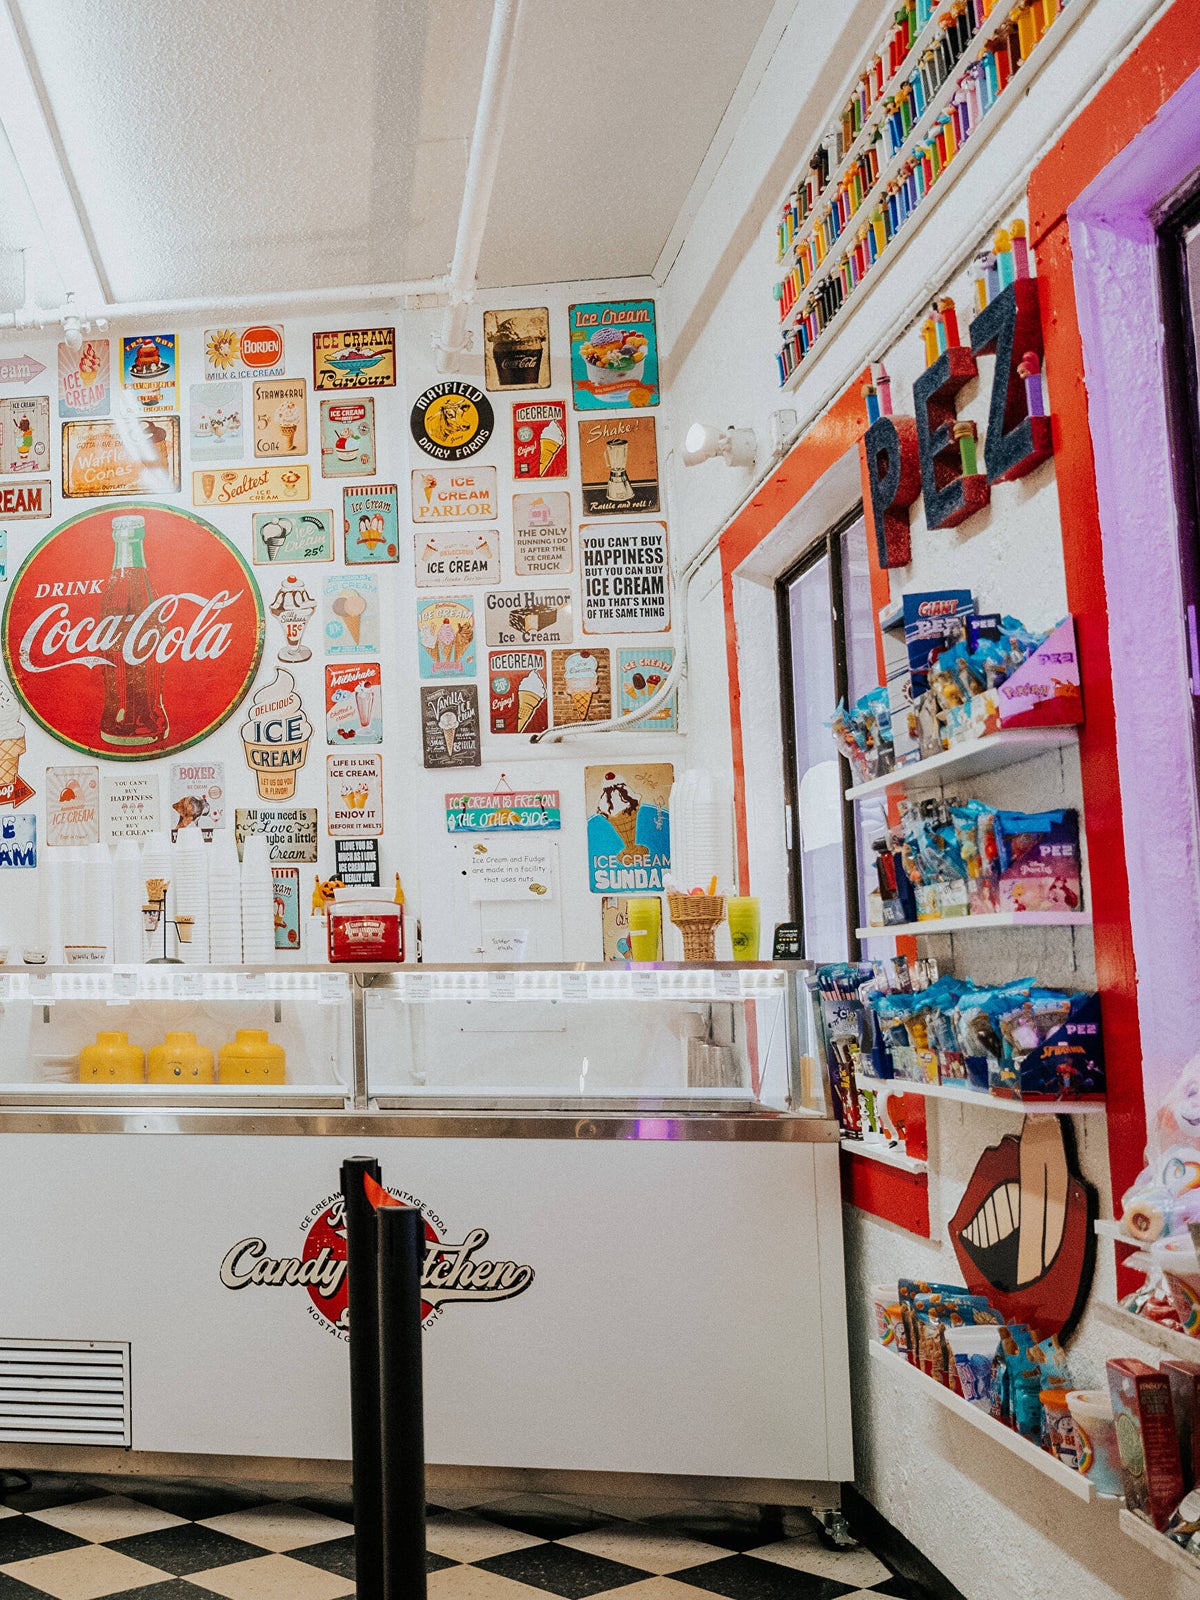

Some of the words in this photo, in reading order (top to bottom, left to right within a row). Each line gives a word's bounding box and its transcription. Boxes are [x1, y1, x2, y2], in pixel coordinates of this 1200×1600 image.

[576, 311, 600, 327] Ice
[601, 308, 651, 325] Cream
[125, 337, 143, 352] TRY
[155, 336, 174, 349] OUR
[243, 340, 279, 354] BORDEN
[315, 333, 339, 349] ICE
[343, 331, 393, 348] CREAM
[501, 356, 537, 369] Coca-Cola
[317, 370, 391, 389] Parlour
[65, 383, 106, 407] CREAM
[256, 387, 304, 400] STRAWBERRY
[416, 382, 484, 410] MAYFIELD
[517, 406, 562, 420] ICECREAM
[864, 278, 1050, 570] PEZ
[418, 436, 451, 459] DAIRY
[455, 429, 490, 458] FARMS
[84, 465, 133, 483] Cones
[218, 470, 269, 502] Sealtest
[450, 477, 475, 487] ICE
[437, 490, 489, 501] CREAM
[351, 501, 362, 514] Ice
[365, 499, 392, 513] Cream
[419, 503, 492, 518] PARLOR
[590, 501, 616, 512] Rattle
[617, 500, 631, 509] and
[583, 538, 605, 549] YOU
[607, 536, 638, 548] CAN'T
[641, 535, 662, 546] BUY
[304, 545, 324, 557] 25¢
[584, 547, 664, 566] HAPPINESS
[427, 562, 444, 574] ICE
[449, 560, 488, 573] CREAM
[527, 563, 560, 571] TRUCK
[35, 579, 104, 599] DRINK
[341, 582, 378, 593] CREAM
[586, 578, 610, 597] ICE
[613, 575, 664, 596] CREAM
[487, 594, 521, 610] Good
[524, 592, 571, 608] Humor
[586, 598, 606, 608] AND
[607, 597, 639, 607] THAT'S
[641, 596, 665, 606] KIND
[918, 599, 959, 616] GIANT
[420, 610, 435, 622] ICE
[436, 608, 474, 620] CREAM
[19, 589, 244, 673] Coca-Cola
[286, 624, 303, 638] 15¢
[971, 619, 996, 629] PEZ
[499, 632, 516, 644] Ice
[522, 631, 561, 643] Cream
[492, 653, 543, 670] ICECREAM
[621, 660, 637, 673] ICE
[639, 658, 672, 672] CREAM
[330, 668, 376, 687] Milkshake
[255, 695, 294, 716] DELICIOUS
[428, 691, 466, 720] VANILLA
[253, 715, 303, 743] ICE
[251, 748, 303, 767] CREAM
[179, 767, 216, 780] BOXER
[330, 770, 344, 778] ICE
[346, 769, 378, 778] CREAM,
[449, 797, 465, 809] ICE
[467, 795, 500, 808] CREAM
[502, 795, 511, 808] IS
[514, 794, 541, 807] FREE
[541, 794, 556, 807] ON
[52, 813, 67, 825] ICE
[68, 808, 95, 823] CREAM
[456, 812, 476, 826] THE
[480, 812, 515, 826] OTHER
[520, 811, 549, 825] SIDE
[269, 845, 306, 860] Cream
[1039, 845, 1073, 857] PEZ
[524, 856, 545, 864] Fudge
[593, 855, 618, 868] ICE
[621, 854, 671, 867] CREAM
[520, 866, 546, 874] facility
[1065, 1024, 1097, 1035] PEZ
[299, 1216, 313, 1231] ICE
[311, 1191, 342, 1216] CREAM
[386, 1187, 427, 1211] VINTAGE
[426, 1209, 448, 1236] SODA
[219, 1237, 347, 1299] Candy
[421, 1228, 536, 1300] tchen
[307, 1305, 351, 1343] NOSTALG
[421, 1307, 444, 1331] TOYS
